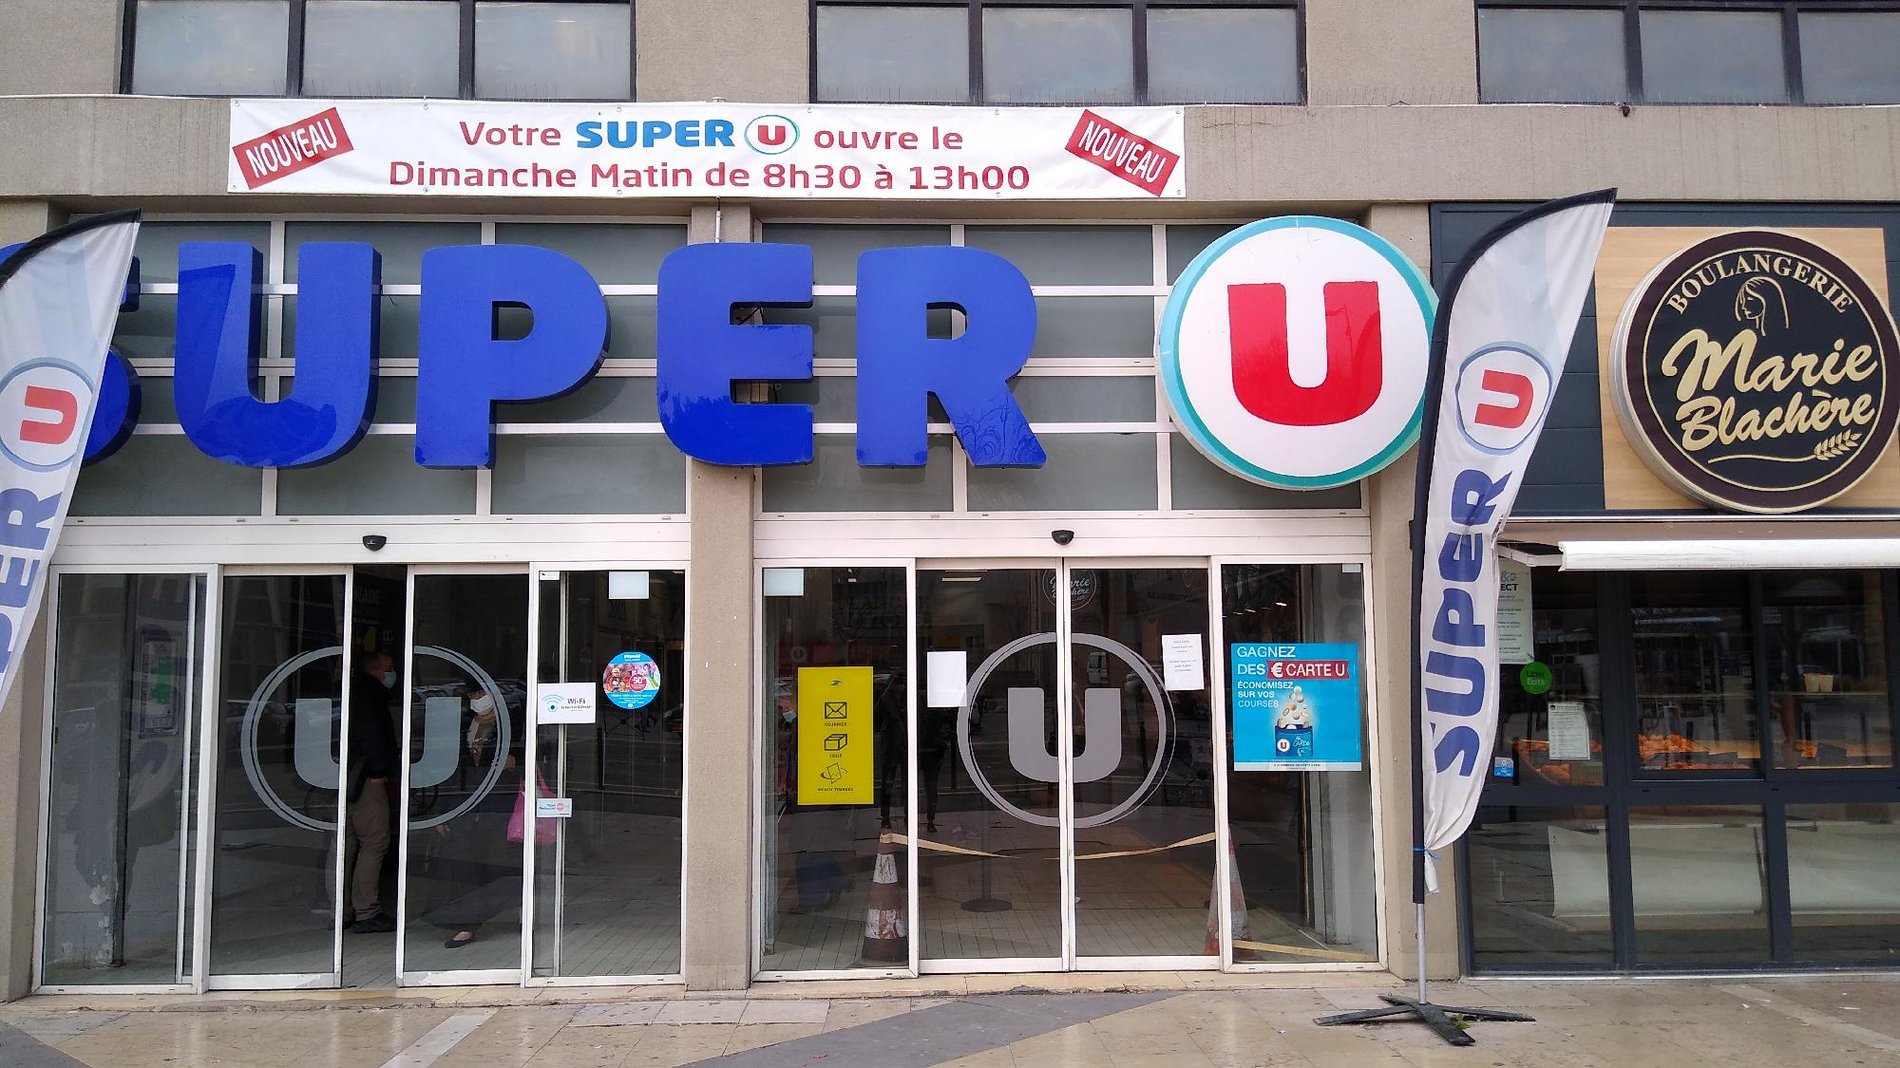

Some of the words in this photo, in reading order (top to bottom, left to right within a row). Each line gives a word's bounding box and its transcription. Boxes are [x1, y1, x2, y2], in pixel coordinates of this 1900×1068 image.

[245, 118, 337, 178] NOUVEAU
[460, 121, 561, 146] Votre
[576, 119, 734, 149] SUPER
[757, 125, 787, 147] U
[814, 130, 918, 151] ouvre
[932, 126, 963, 150] le
[1078, 120, 1166, 183] NOUVEAU
[390, 161, 576, 188] Dimanche
[591, 164, 693, 188] Matin
[705, 162, 750, 187] de
[763, 163, 862, 190] 8h30
[874, 163, 893, 190] à
[909, 165, 1030, 191] 13h00
[1665, 253, 1854, 315] BOULANGERIE
[1227, 281, 1383, 427] U
[1661, 328, 1878, 402] Marie
[20, 385, 78, 445] U
[1675, 389, 1876, 452] Blachère
[1426, 469, 1515, 778] SUPER
[1474, 369, 1535, 430] U
[1236, 646, 1296, 658] GAGNEZ
[1237, 663, 1266, 675] DES
[1286, 663, 1332, 677] CARTE
[1335, 663, 1345, 676] U
[1237, 680, 1294, 689] ÉCONOMISEZ
[1238, 700, 1279, 708] COURSES
[1008, 687, 1122, 783] U
